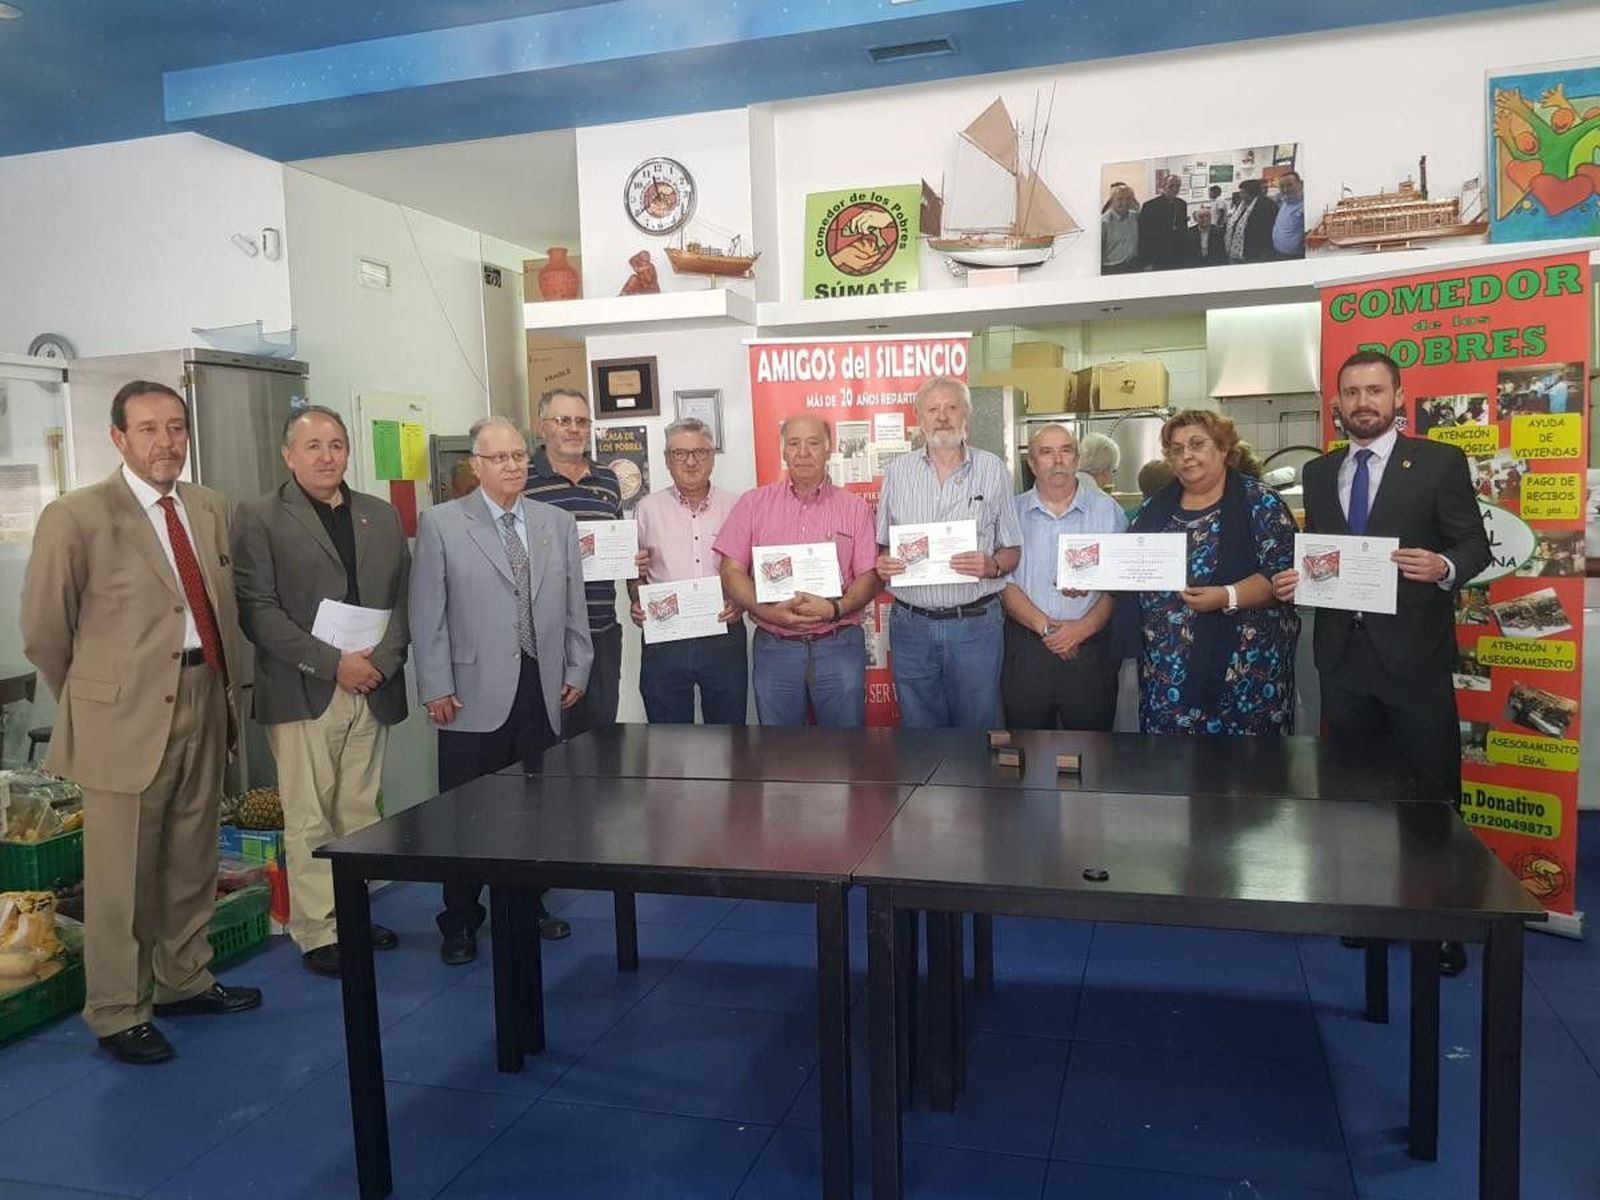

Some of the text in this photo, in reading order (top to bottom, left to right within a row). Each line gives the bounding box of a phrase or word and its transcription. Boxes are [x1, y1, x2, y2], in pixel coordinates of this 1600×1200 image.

[815, 191, 909, 258] Comedor de los Pobres
[1329, 263, 1583, 323] COMEDOR
[1411, 315, 1490, 332] de los
[757, 342, 967, 383] AMIGOS del SILENCIO
[806, 392, 823, 409] MÁS
[825, 395, 837, 408] DE
[840, 386, 854, 408] 20
[856, 391, 879, 406] AÑOS
[1528, 418, 1566, 428] AYUDA
[1437, 427, 1490, 440] ATENCIÓN
[1539, 432, 1553, 443] DE
[1515, 447, 1579, 458] VIVIENDAS
[1527, 476, 1575, 487] PAGO DE
[1526, 491, 1576, 501] RECIBOS
[1491, 639, 1562, 653] ATENCIÓN Y
[1481, 654, 1574, 669] ASESORAMIENTO
[1491, 737, 1579, 755] ASESORAMIENTO
[1518, 755, 1547, 767] LEGAL
[1475, 788, 1545, 818] Donativo
